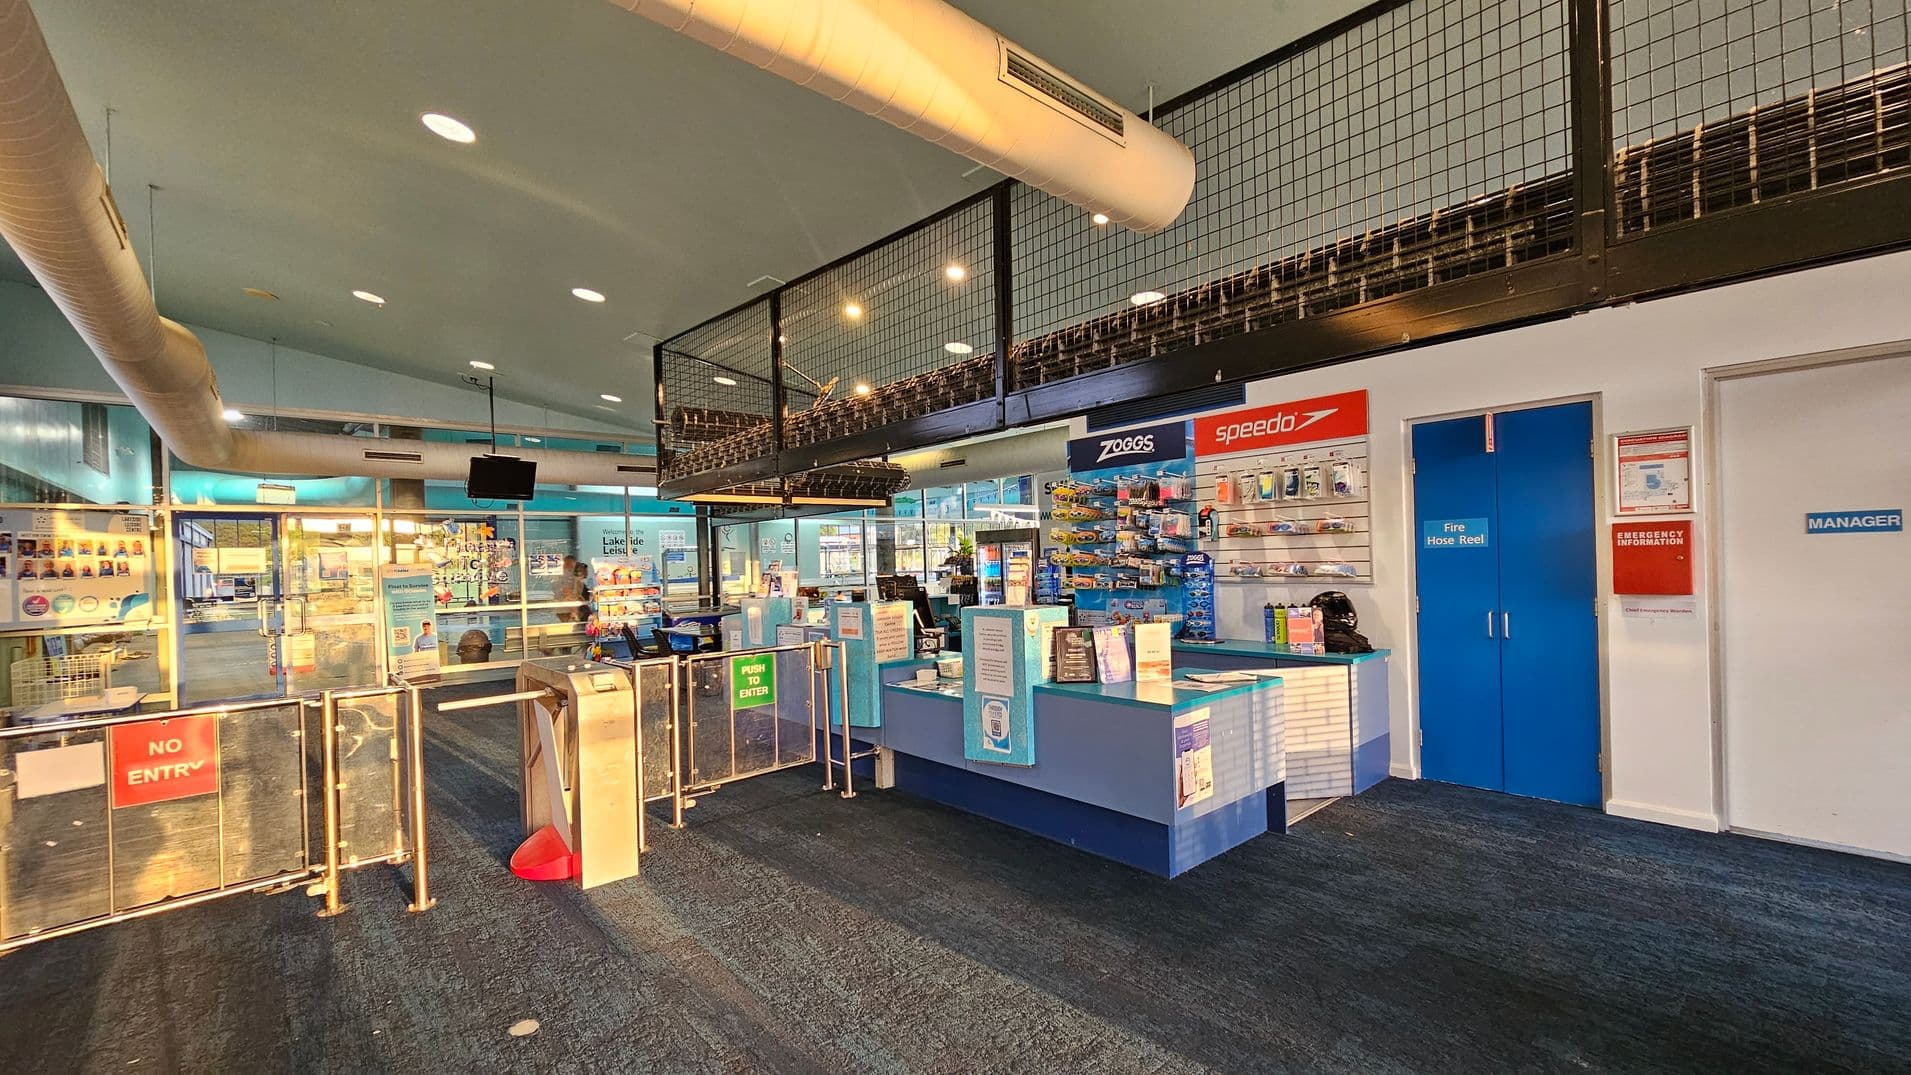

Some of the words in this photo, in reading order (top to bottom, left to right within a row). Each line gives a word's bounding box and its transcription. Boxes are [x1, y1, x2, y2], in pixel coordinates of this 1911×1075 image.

[1215, 411, 1296, 446] speedo
[1096, 434, 1155, 463] ZOGGS
[1444, 522, 1466, 533] Fire
[1808, 514, 1901, 529] MANAGER
[602, 536, 645, 546] Lakeide
[1427, 535, 1455, 546] Hose
[1459, 533, 1485, 545] Reel
[1617, 530, 1684, 540] EMERGENCY
[1617, 538, 1684, 547] INFORMATION
[602, 546, 639, 555] Leisue
[741, 663, 765, 675] PUSH
[747, 675, 761, 686] TO
[739, 686, 769, 699] ENTER
[148, 738, 183, 757] NO
